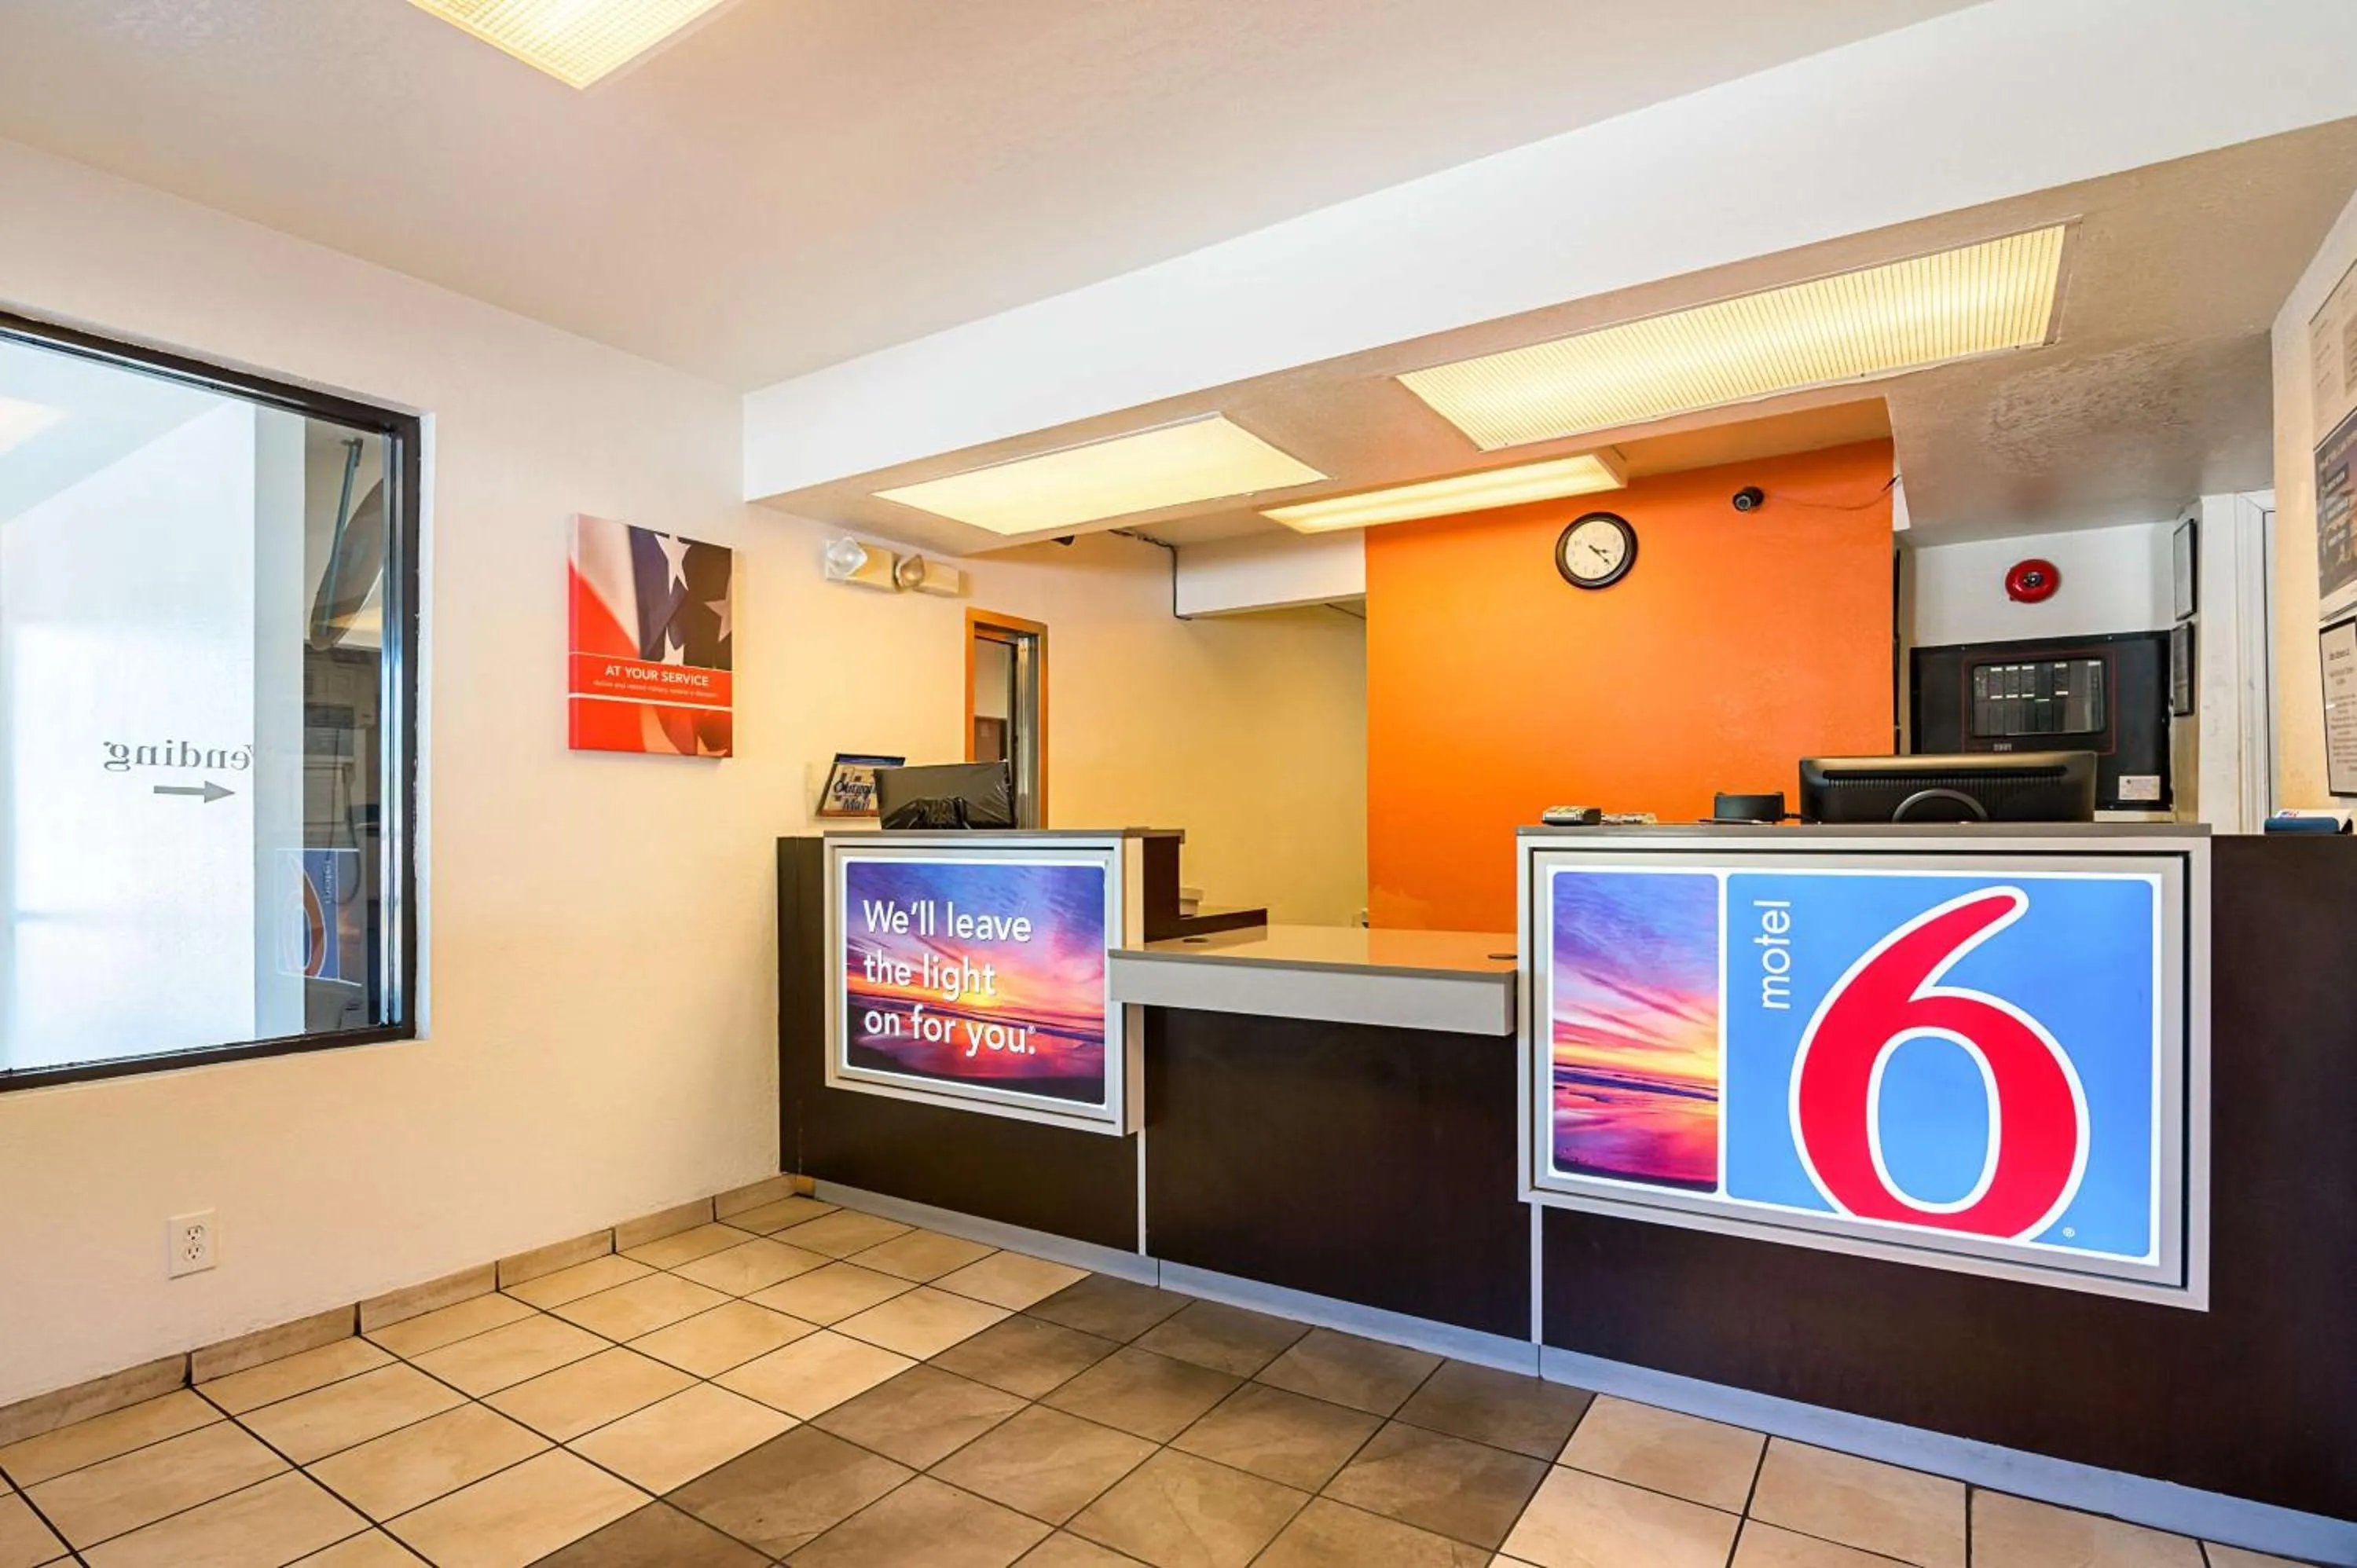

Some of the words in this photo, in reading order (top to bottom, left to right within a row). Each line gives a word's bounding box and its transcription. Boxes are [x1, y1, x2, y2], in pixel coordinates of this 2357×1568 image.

[605, 665, 621, 676] AT
[624, 666, 658, 681] YOUR
[661, 670, 709, 687] SERVICE
[863, 899, 935, 936] We'll
[947, 901, 1032, 943] leave
[863, 949, 912, 987] the
[922, 953, 997, 1002] light
[1753, 899, 1791, 1009] motel
[864, 1009, 901, 1037] on
[911, 1003, 957, 1045] for
[1788, 885, 2091, 1244] 6
